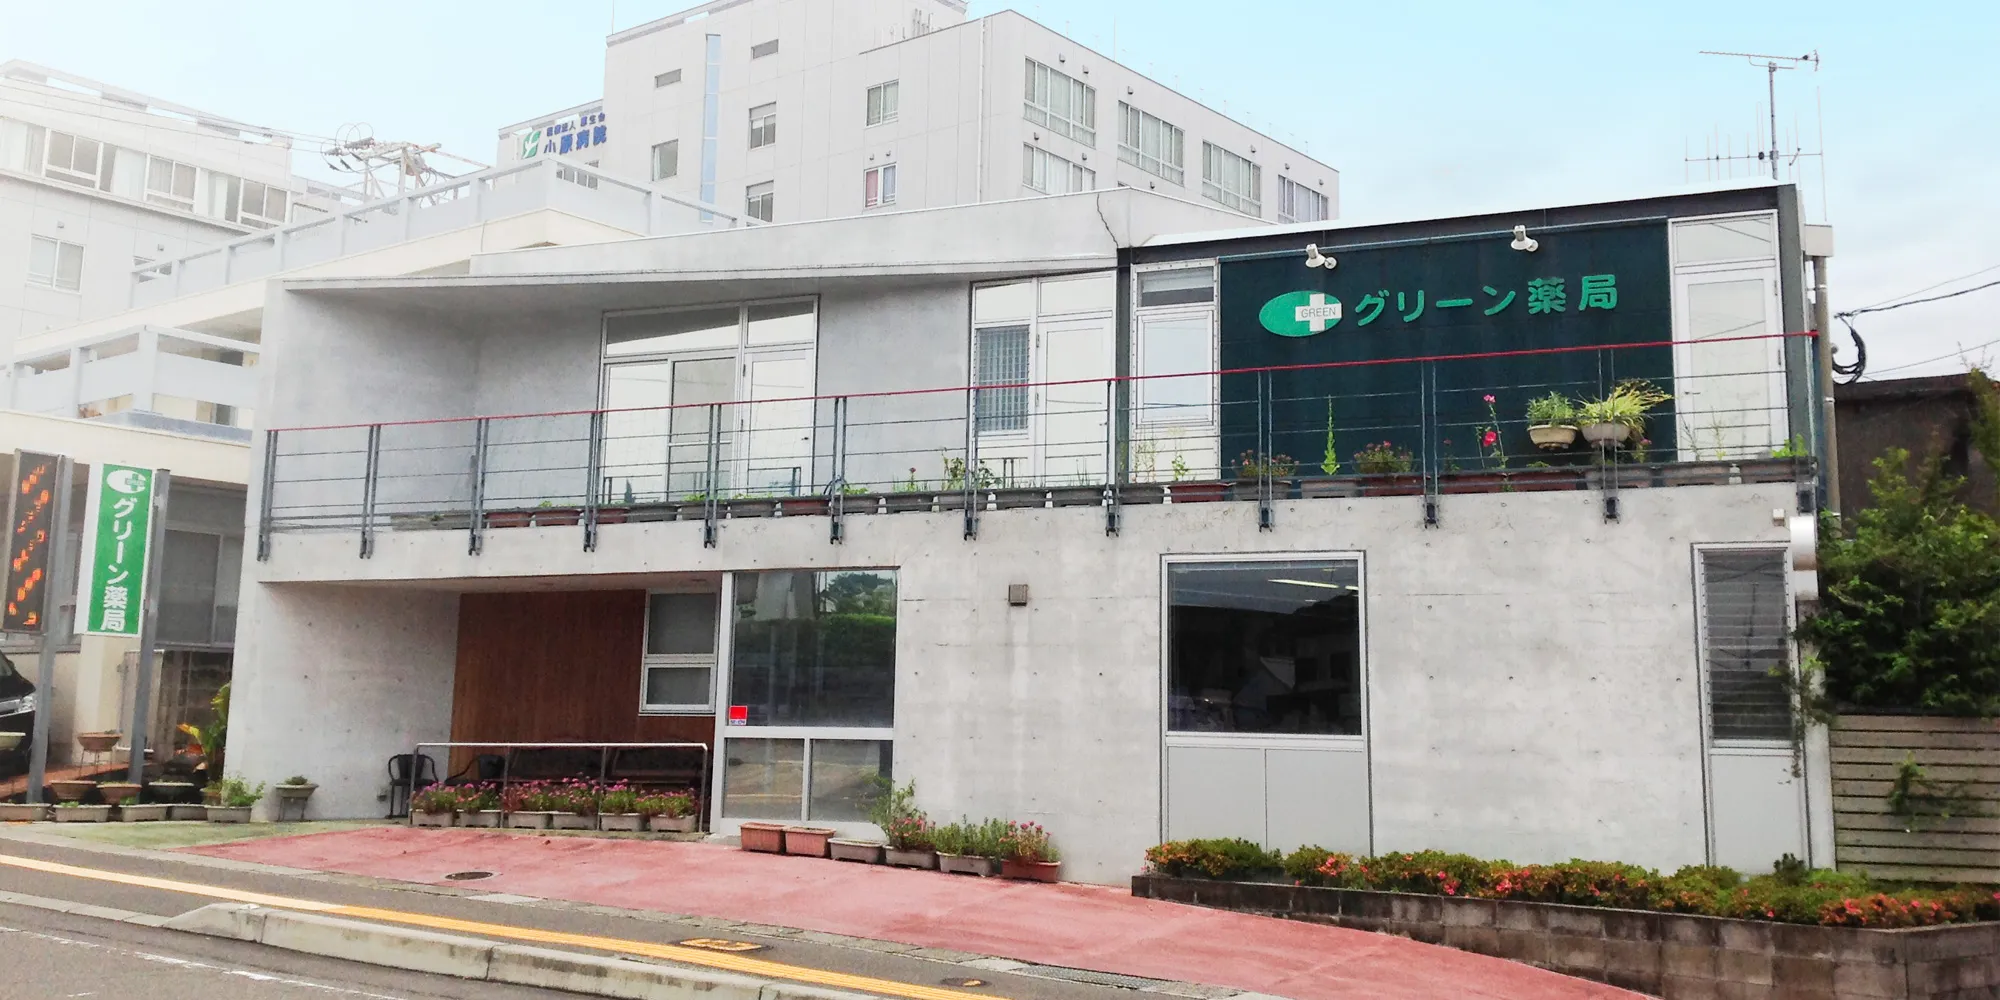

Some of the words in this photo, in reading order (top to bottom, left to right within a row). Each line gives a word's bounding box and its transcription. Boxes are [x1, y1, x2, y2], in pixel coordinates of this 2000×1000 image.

[1301, 306, 1337, 318] GREEN
[1355, 274, 1617, 326] グリーン薬局
[100, 498, 137, 631] グリーン薬局
